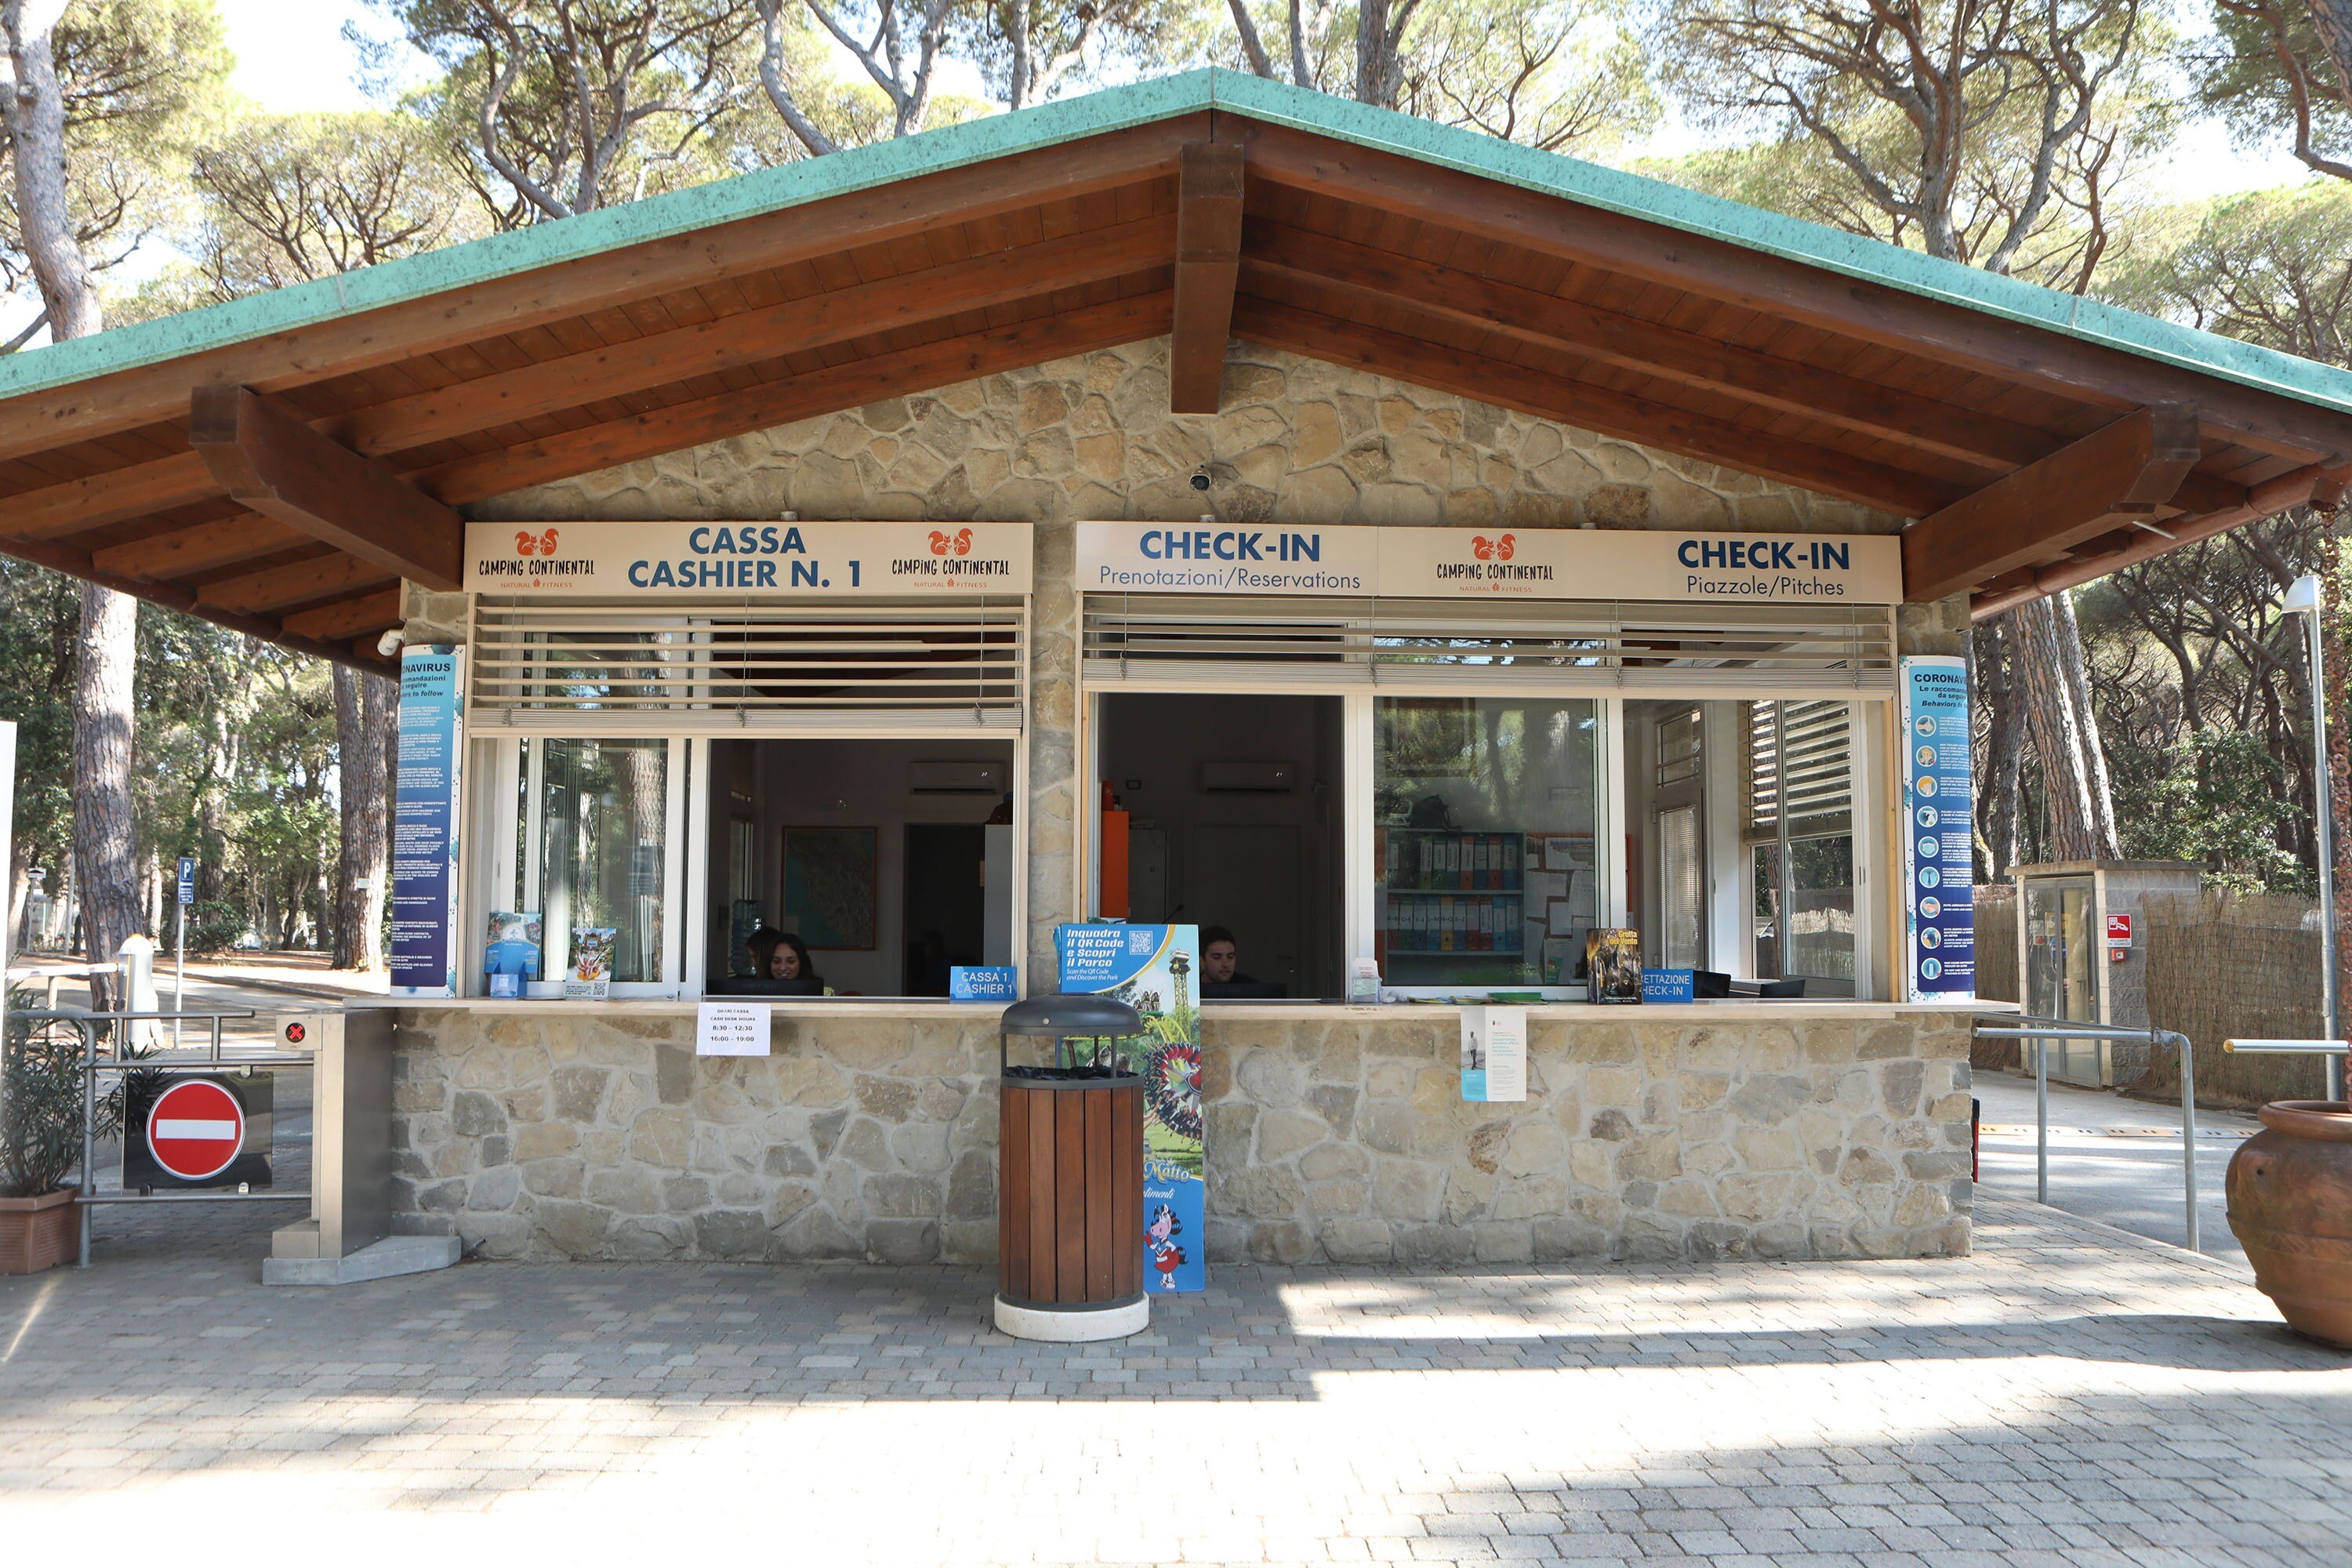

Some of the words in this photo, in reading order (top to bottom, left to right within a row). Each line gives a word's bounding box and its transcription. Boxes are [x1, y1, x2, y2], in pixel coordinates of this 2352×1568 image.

[689, 527, 806, 554] CASSA
[1139, 531, 1320, 562] CHECK-IN
[1677, 540, 1849, 570] CHECK-IN
[628, 560, 777, 588] CASHIER
[792, 560, 830, 588] N.
[849, 560, 860, 587] 1
[1100, 565, 1360, 590] Prenotazioni/Reservations
[1688, 575, 1845, 597] Piazzole/Pitches
[183, 862, 191, 878] P
[1067, 929, 1120, 938] Inquadra
[1618, 930, 1637, 938] Grotta
[1067, 938, 1075, 948] il
[1078, 939, 1094, 949] QR
[1095, 938, 1124, 948] Code
[1077, 948, 1116, 958] Scopri
[1067, 958, 1075, 967] il
[1077, 958, 1112, 967] Parco
[961, 972, 1000, 982] CASSA
[1004, 972, 1007, 982] 1
[956, 984, 1004, 993] CASHIER
[1008, 984, 1012, 994] 1
[1144, 1160, 1190, 1184] Matto
